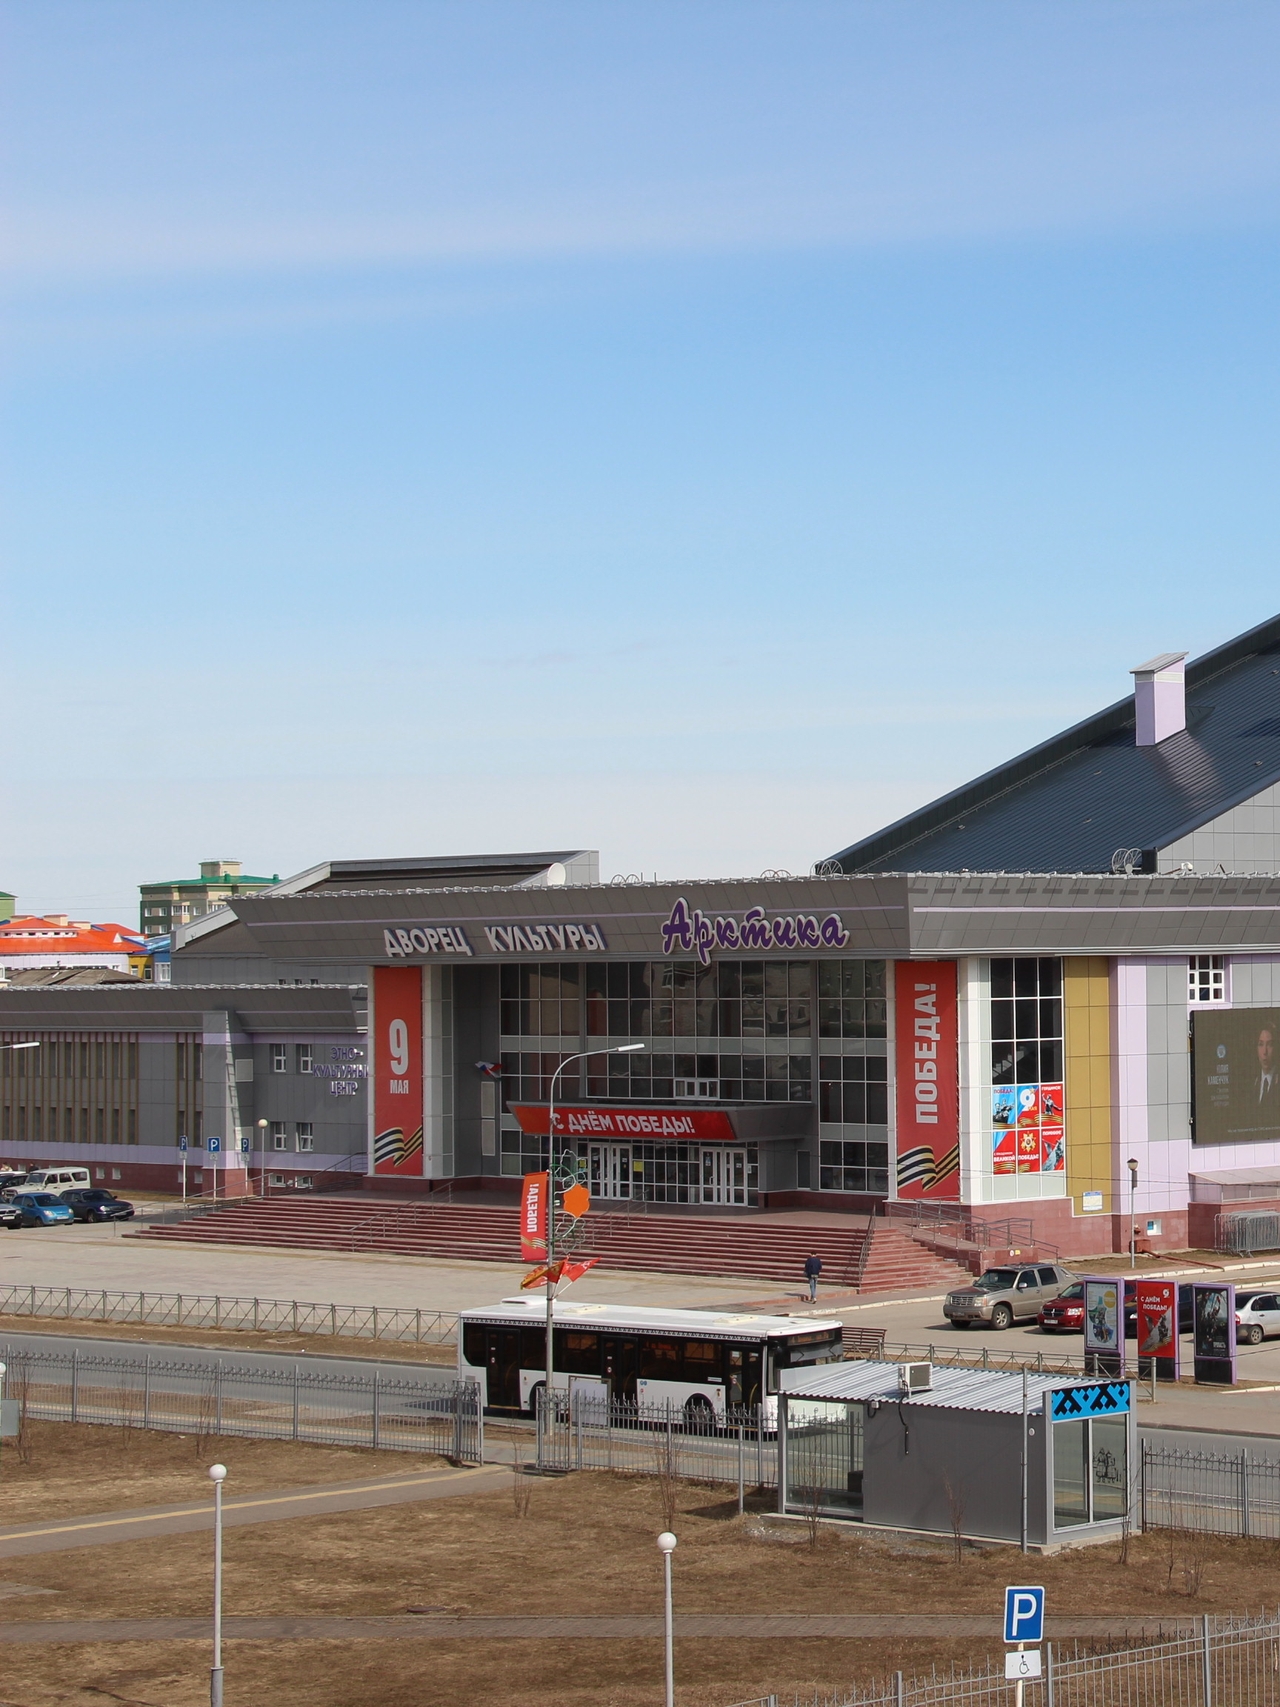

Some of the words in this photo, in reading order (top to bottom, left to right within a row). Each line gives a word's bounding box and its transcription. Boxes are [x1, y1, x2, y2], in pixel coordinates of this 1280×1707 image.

[384, 926, 475, 958] ДВОРЕЦ
[484, 923, 608, 952] КУЛЬТУРЫ
[662, 897, 849, 966] Арктика
[331, 1046, 364, 1061] ЭТНО-
[389, 1018, 409, 1076] 9
[915, 983, 940, 1124] ПОБЕДА!
[313, 1063, 368, 1079] КУЛЬТУРНЫ
[330, 1080, 358, 1097] ЦЕНТР
[390, 1079, 409, 1095] МАЯ
[550, 1111, 564, 1130] С
[567, 1111, 615, 1134] ДНЁМ
[615, 1114, 696, 1137] ПОБЕДЫ!
[211, 1139, 218, 1151] P
[1011, 1593, 1037, 1637] P
